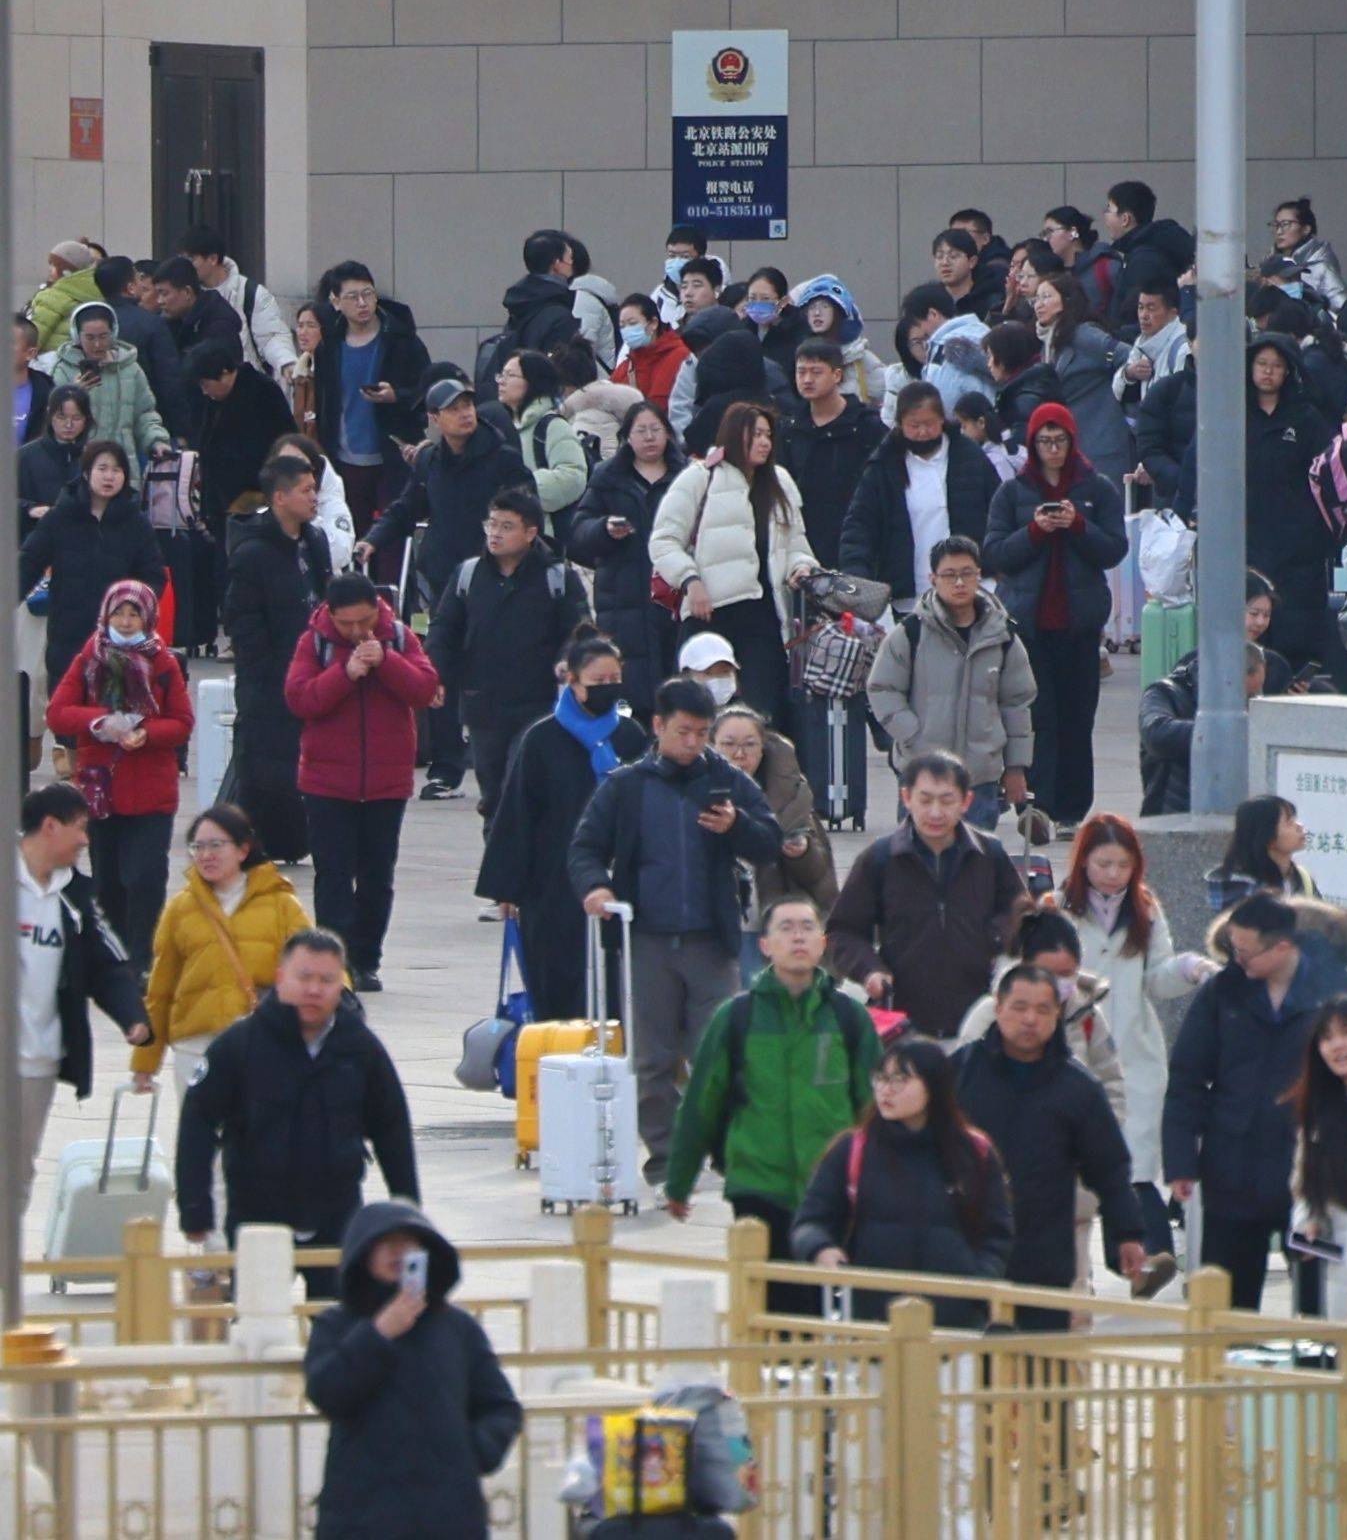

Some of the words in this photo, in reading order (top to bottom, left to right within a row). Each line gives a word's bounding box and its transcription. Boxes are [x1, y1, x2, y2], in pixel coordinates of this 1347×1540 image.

[684, 125, 777, 140] 北京铁路公安处
[692, 142, 769, 156] 北京站派出所
[706, 181, 754, 195] 报警电话
[687, 205, 772, 217] 010-51835110
[17, 924, 62, 948] FILA
